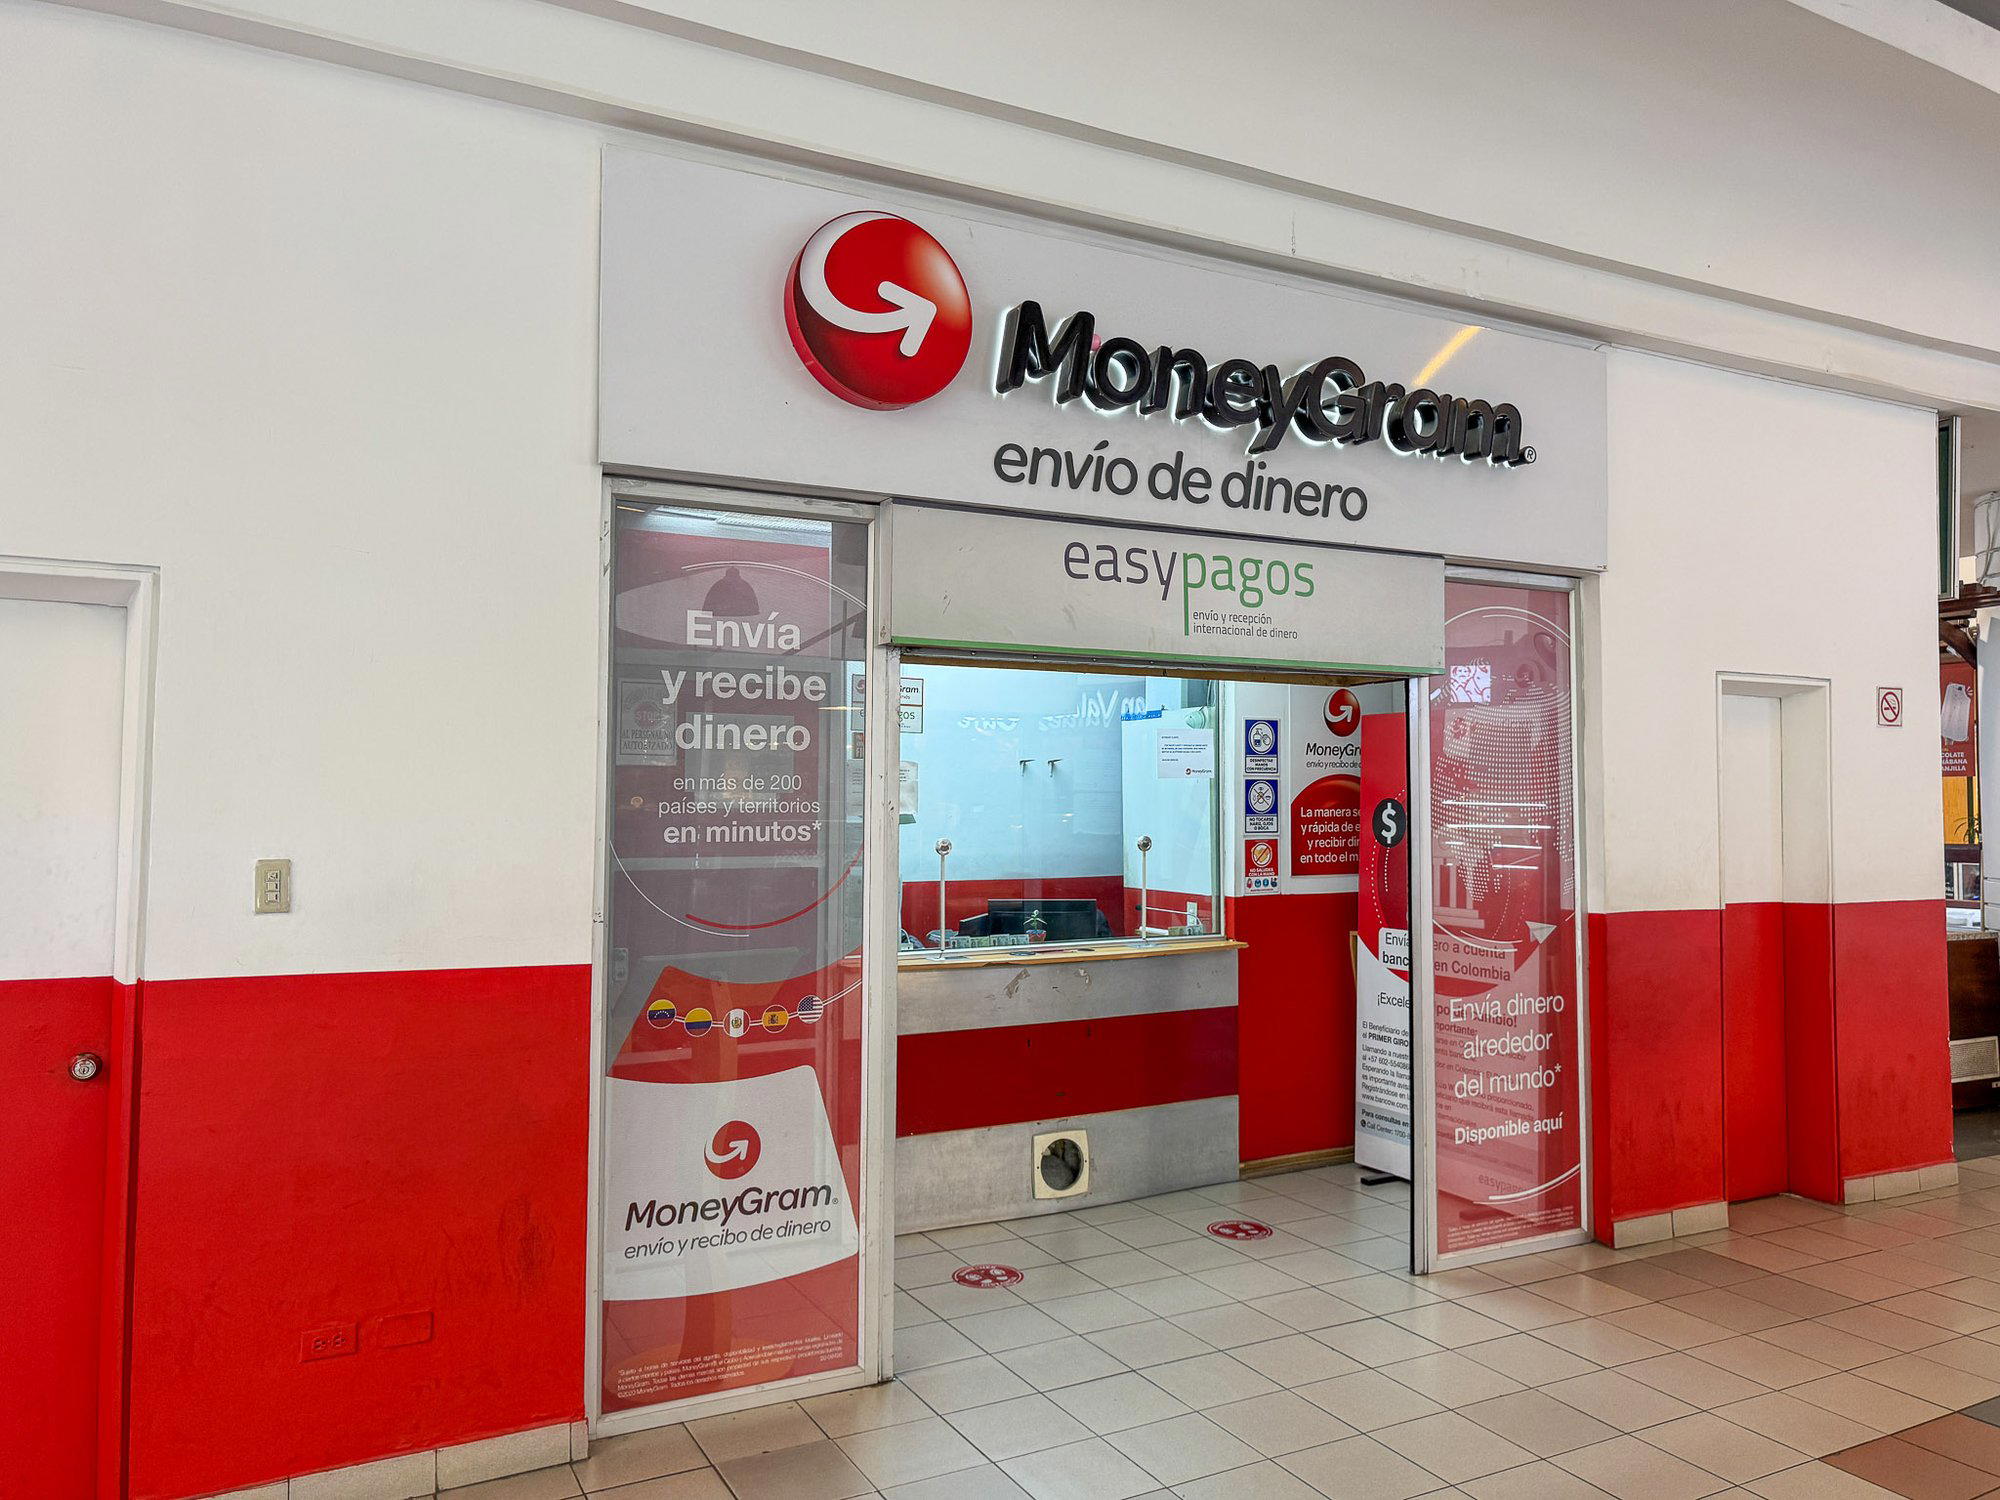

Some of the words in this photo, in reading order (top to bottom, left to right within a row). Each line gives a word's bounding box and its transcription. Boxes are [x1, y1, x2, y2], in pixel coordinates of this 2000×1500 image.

[994, 439, 1138, 496] envío
[1148, 451, 1212, 504] de
[1221, 460, 1368, 522] dinero
[1064, 541, 1315, 636] easypagos
[1193, 610, 1219, 621] envío
[1221, 612, 1226, 623] y
[1229, 613, 1272, 625] recepción
[686, 609, 801, 649] Envía
[1193, 623, 1254, 637] internacional
[1256, 627, 1268, 637] de
[1269, 628, 1298, 640] dinero
[661, 669, 686, 705] y
[694, 665, 827, 701] recibe
[675, 714, 811, 751] dinero
[1306, 742, 1361, 759] MoneyGr
[673, 777, 695, 790] en
[700, 773, 737, 790] más
[743, 775, 765, 790] de
[770, 775, 802, 790] 200
[658, 797, 717, 818] países
[723, 800, 733, 817] y
[738, 798, 821, 813] territorios
[1300, 807, 1313, 818] La
[1314, 809, 1351, 817] manera
[663, 825, 696, 843] en
[1300, 824, 1307, 835] y
[1308, 821, 1340, 835] rápida
[1341, 821, 1354, 832] de
[1307, 839, 1313, 850] y
[1314, 836, 1346, 848] recibir
[1300, 854, 1313, 863] en
[1314, 852, 1338, 863] todo
[1339, 851, 1348, 862] el
[1433, 940, 1449, 952] ero
[1382, 951, 1409, 966] banc
[1451, 961, 1511, 982] Colombia
[1377, 992, 1410, 1008] ¡Excele
[1449, 993, 1501, 1022] Envía
[1506, 992, 1565, 1016] dinero
[1368, 1032, 1392, 1044] PRIMER
[1464, 1029, 1553, 1059] alrededor
[1454, 1073, 1483, 1099] del
[1454, 1119, 1530, 1145] Disponible
[1533, 1111, 1564, 1134] aquí
[624, 1237, 675, 1259] envío
[677, 1238, 689, 1257] y
[690, 1229, 748, 1250] recibo
[751, 1224, 773, 1242] de
[776, 1219, 831, 1238] dinero
